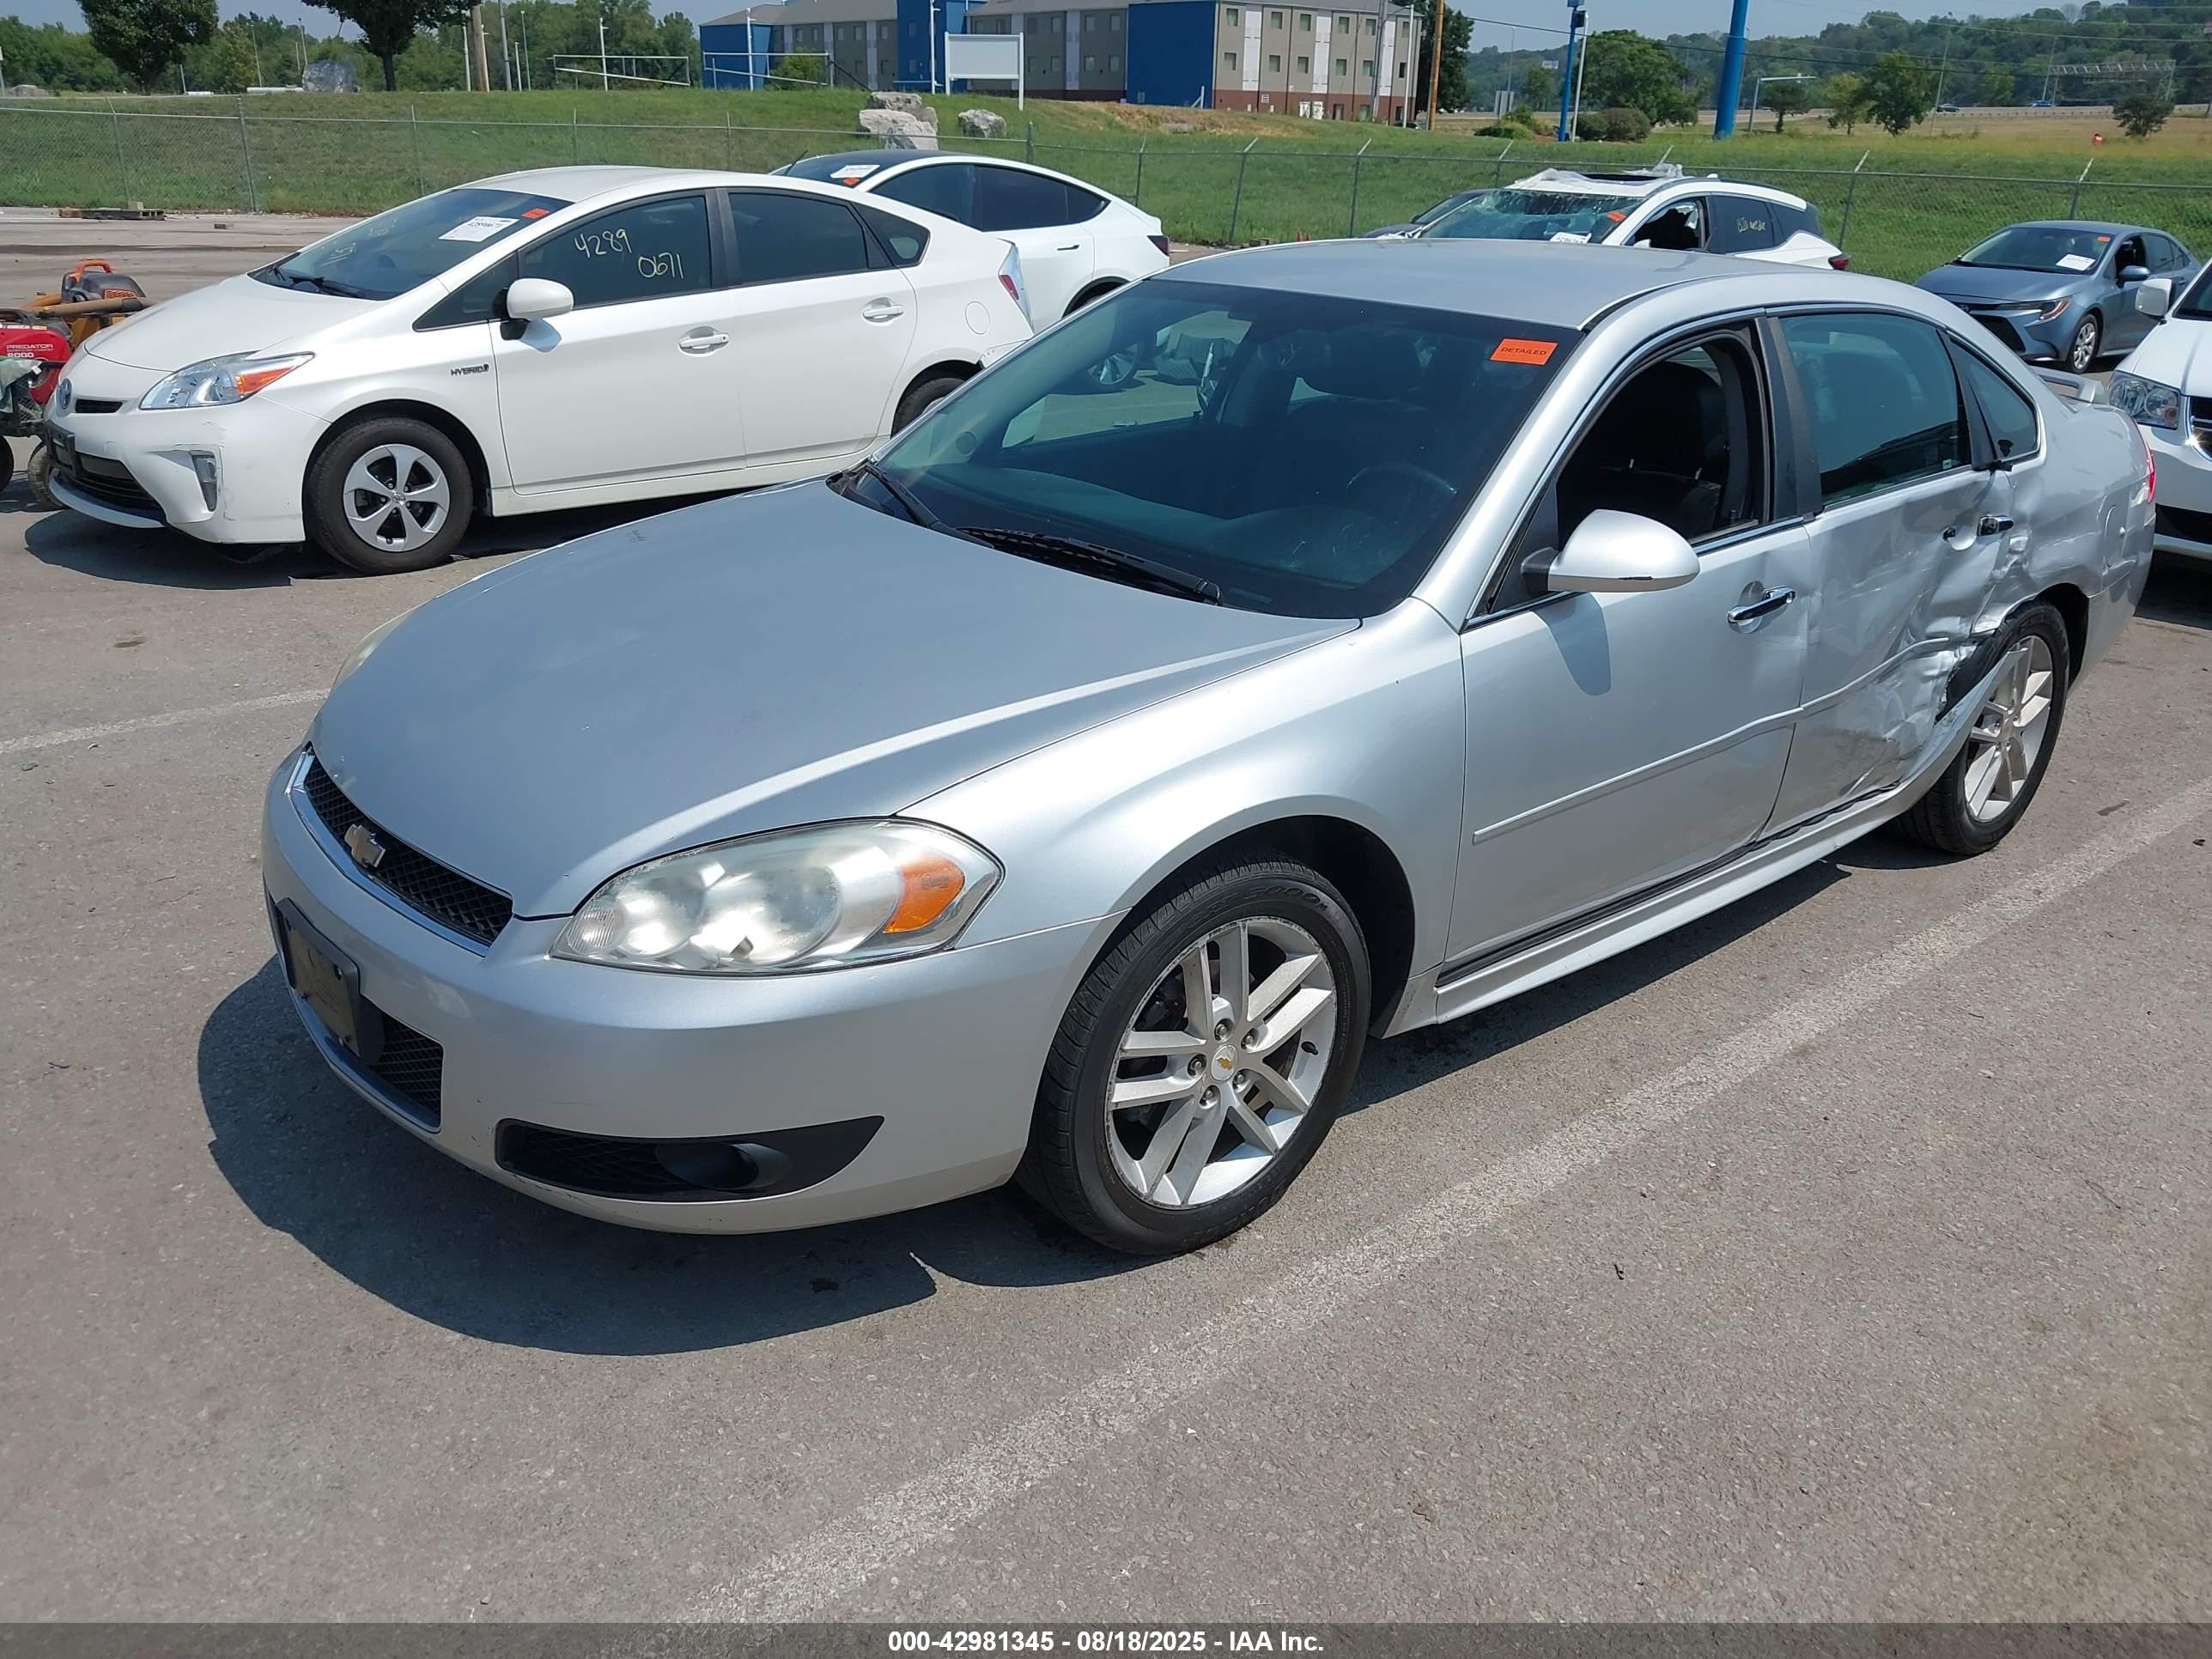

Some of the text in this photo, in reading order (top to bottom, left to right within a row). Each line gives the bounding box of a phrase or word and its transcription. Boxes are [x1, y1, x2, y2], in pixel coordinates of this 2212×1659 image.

[574, 228, 633, 258] 4289
[637, 252, 685, 279] 0671
[1500, 346, 1547, 356] DETAILED
